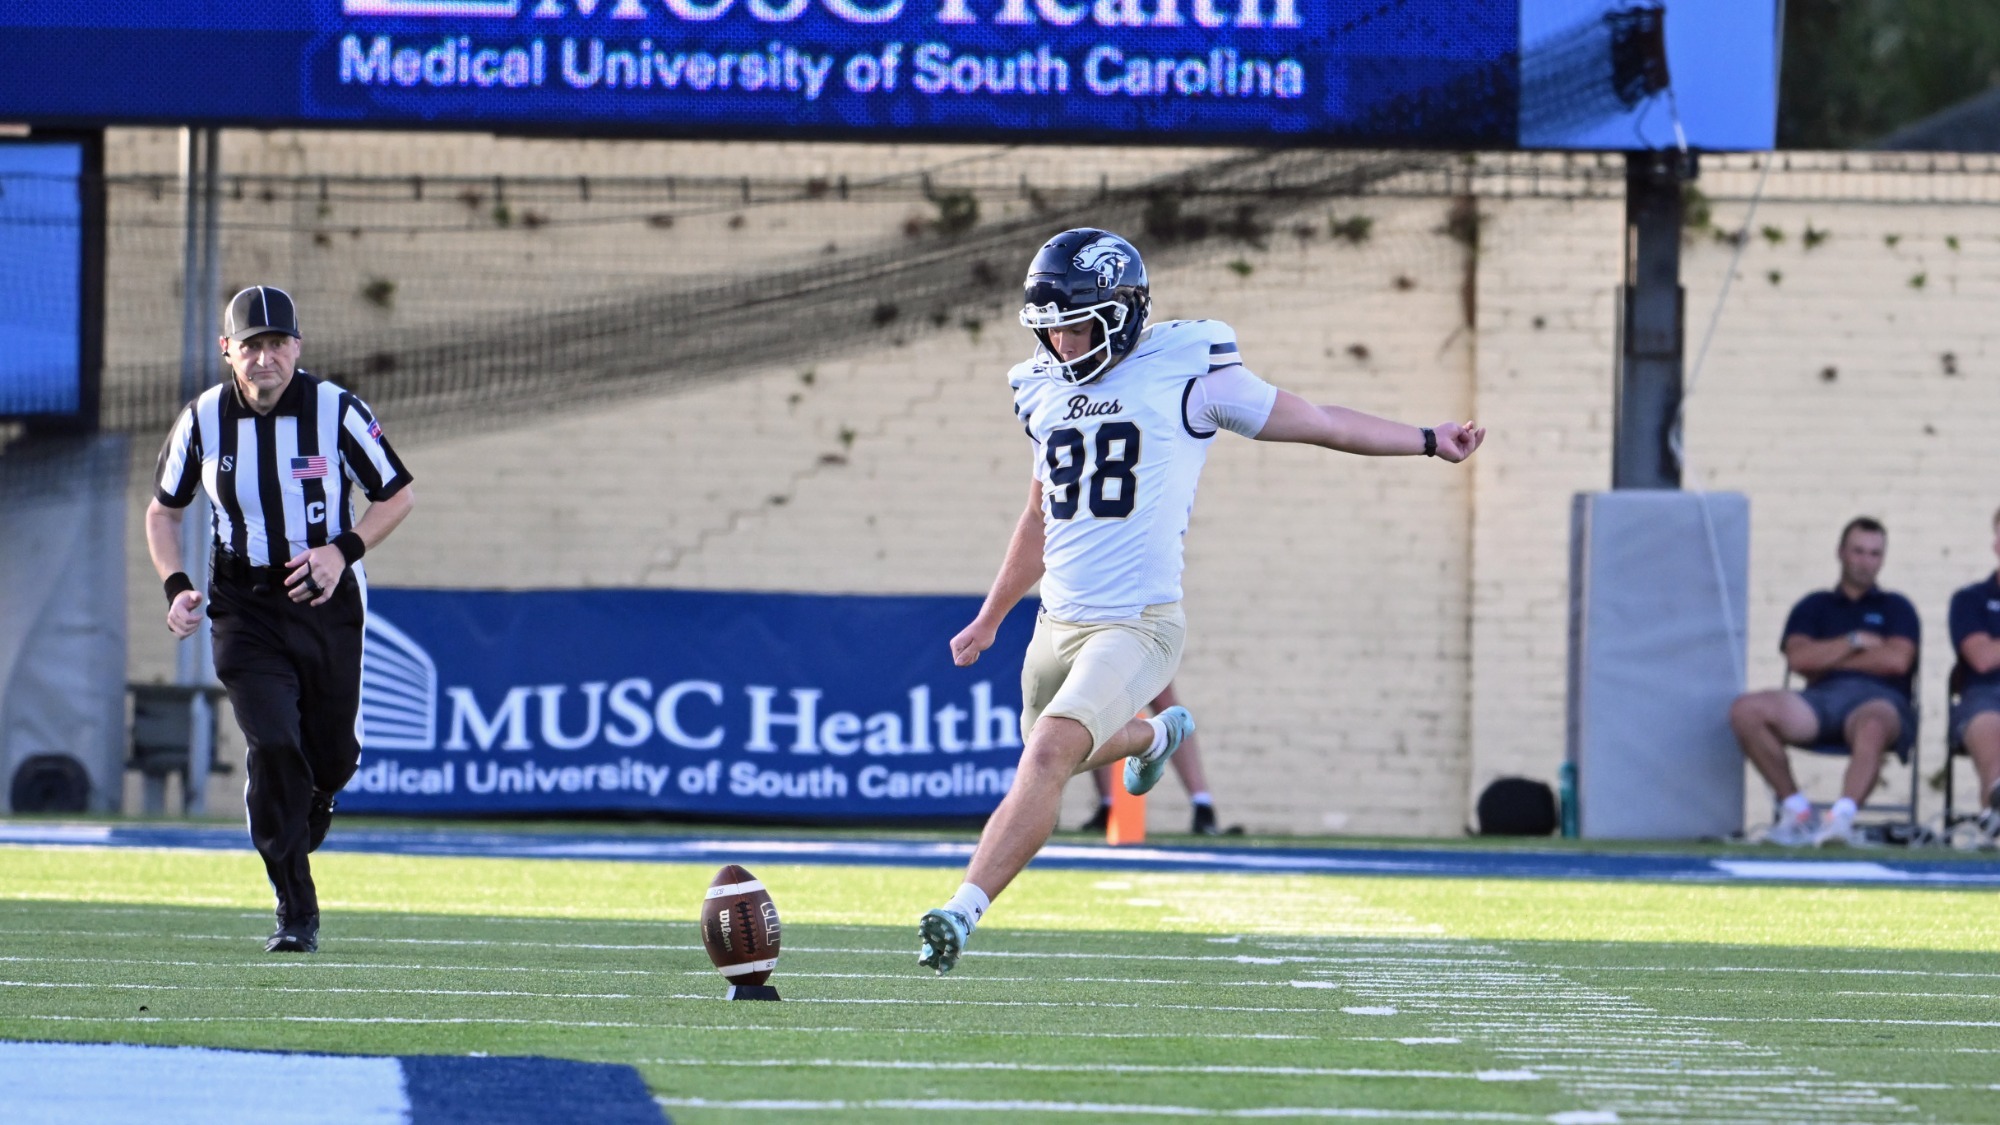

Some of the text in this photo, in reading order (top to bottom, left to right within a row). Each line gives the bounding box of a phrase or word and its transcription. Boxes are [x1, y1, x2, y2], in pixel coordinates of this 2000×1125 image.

[340, 34, 1304, 100] Medical University of South Carolina
[1063, 394, 1123, 421] Bucs
[221, 455, 234, 472] S
[1046, 420, 1143, 520] 98
[307, 501, 325, 525] C
[444, 678, 1021, 755] MUSC Health
[465, 757, 669, 797] University
[678, 760, 721, 794] of
[729, 762, 848, 798] South
